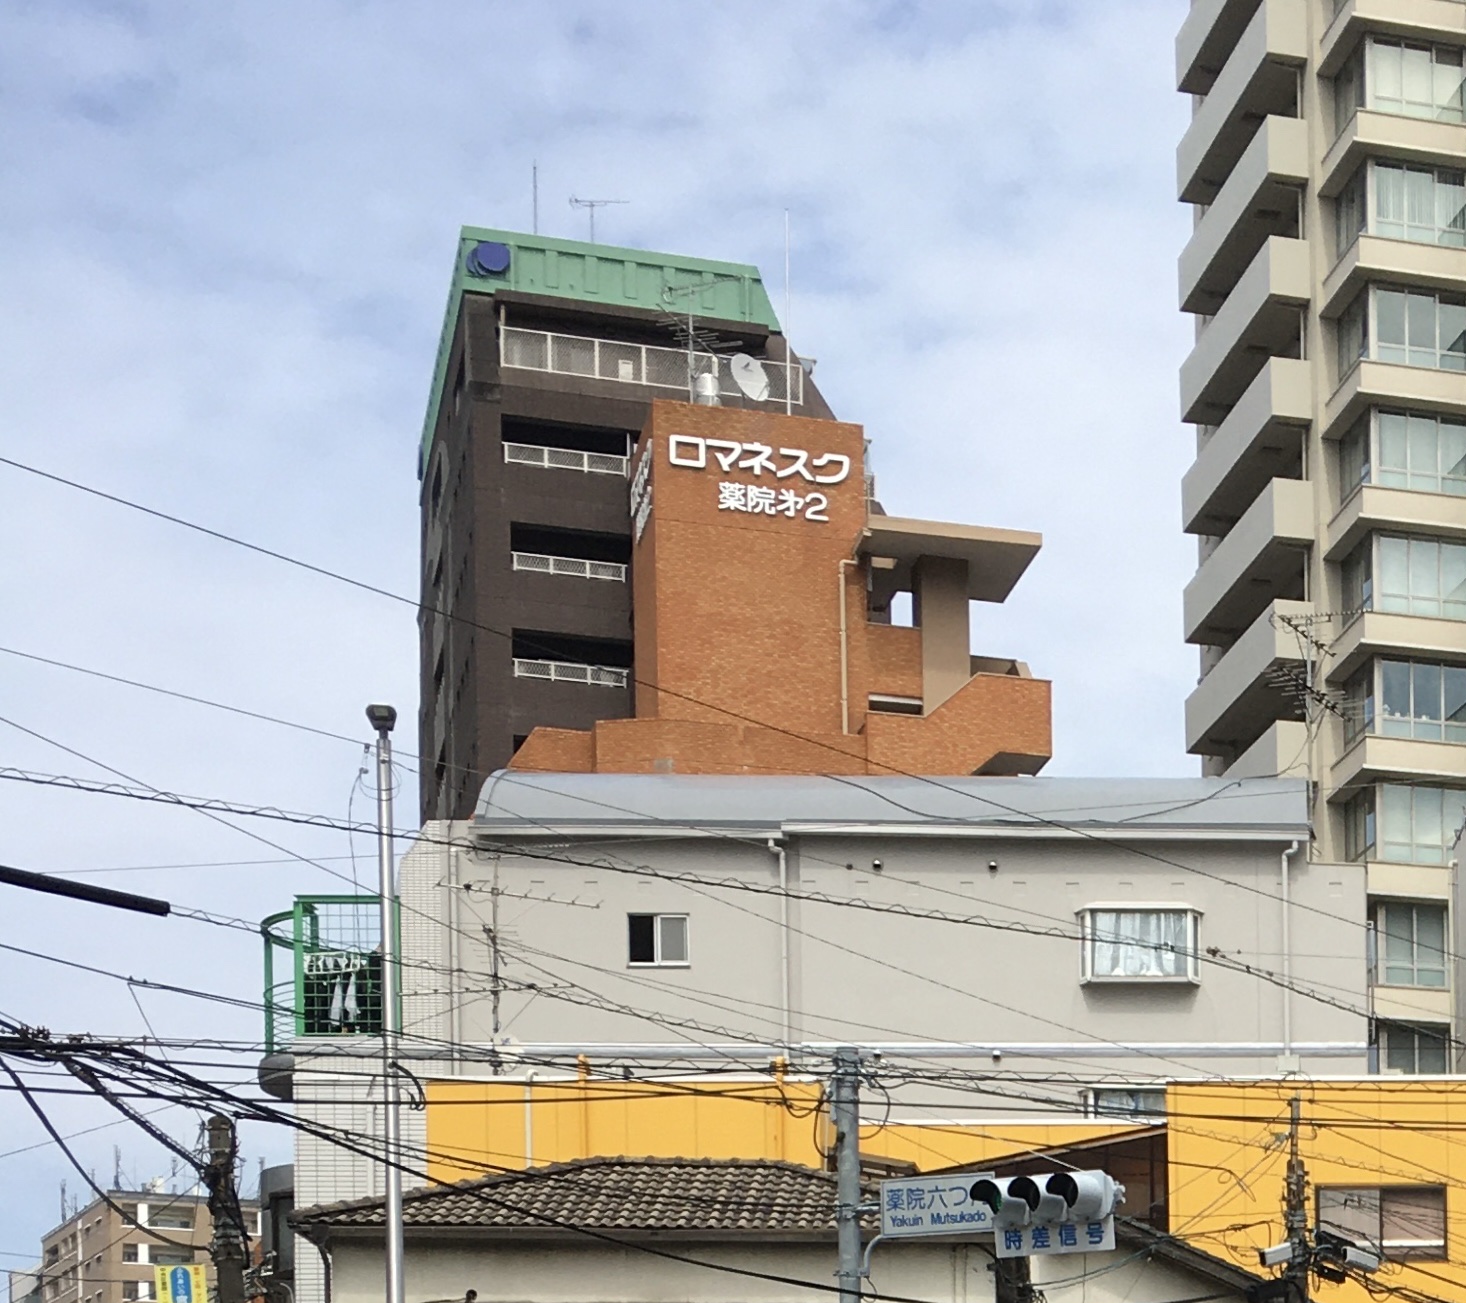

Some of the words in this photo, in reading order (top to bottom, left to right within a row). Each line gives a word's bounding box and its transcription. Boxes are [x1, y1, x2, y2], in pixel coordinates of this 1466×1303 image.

[669, 434, 850, 484] ロマネスク
[886, 1185, 988, 1211] 薬院六つ
[890, 1214, 923, 1228] Yakuin
[931, 1211, 987, 1226] Mutsukado
[1004, 1222, 1105, 1250] 時差信号
